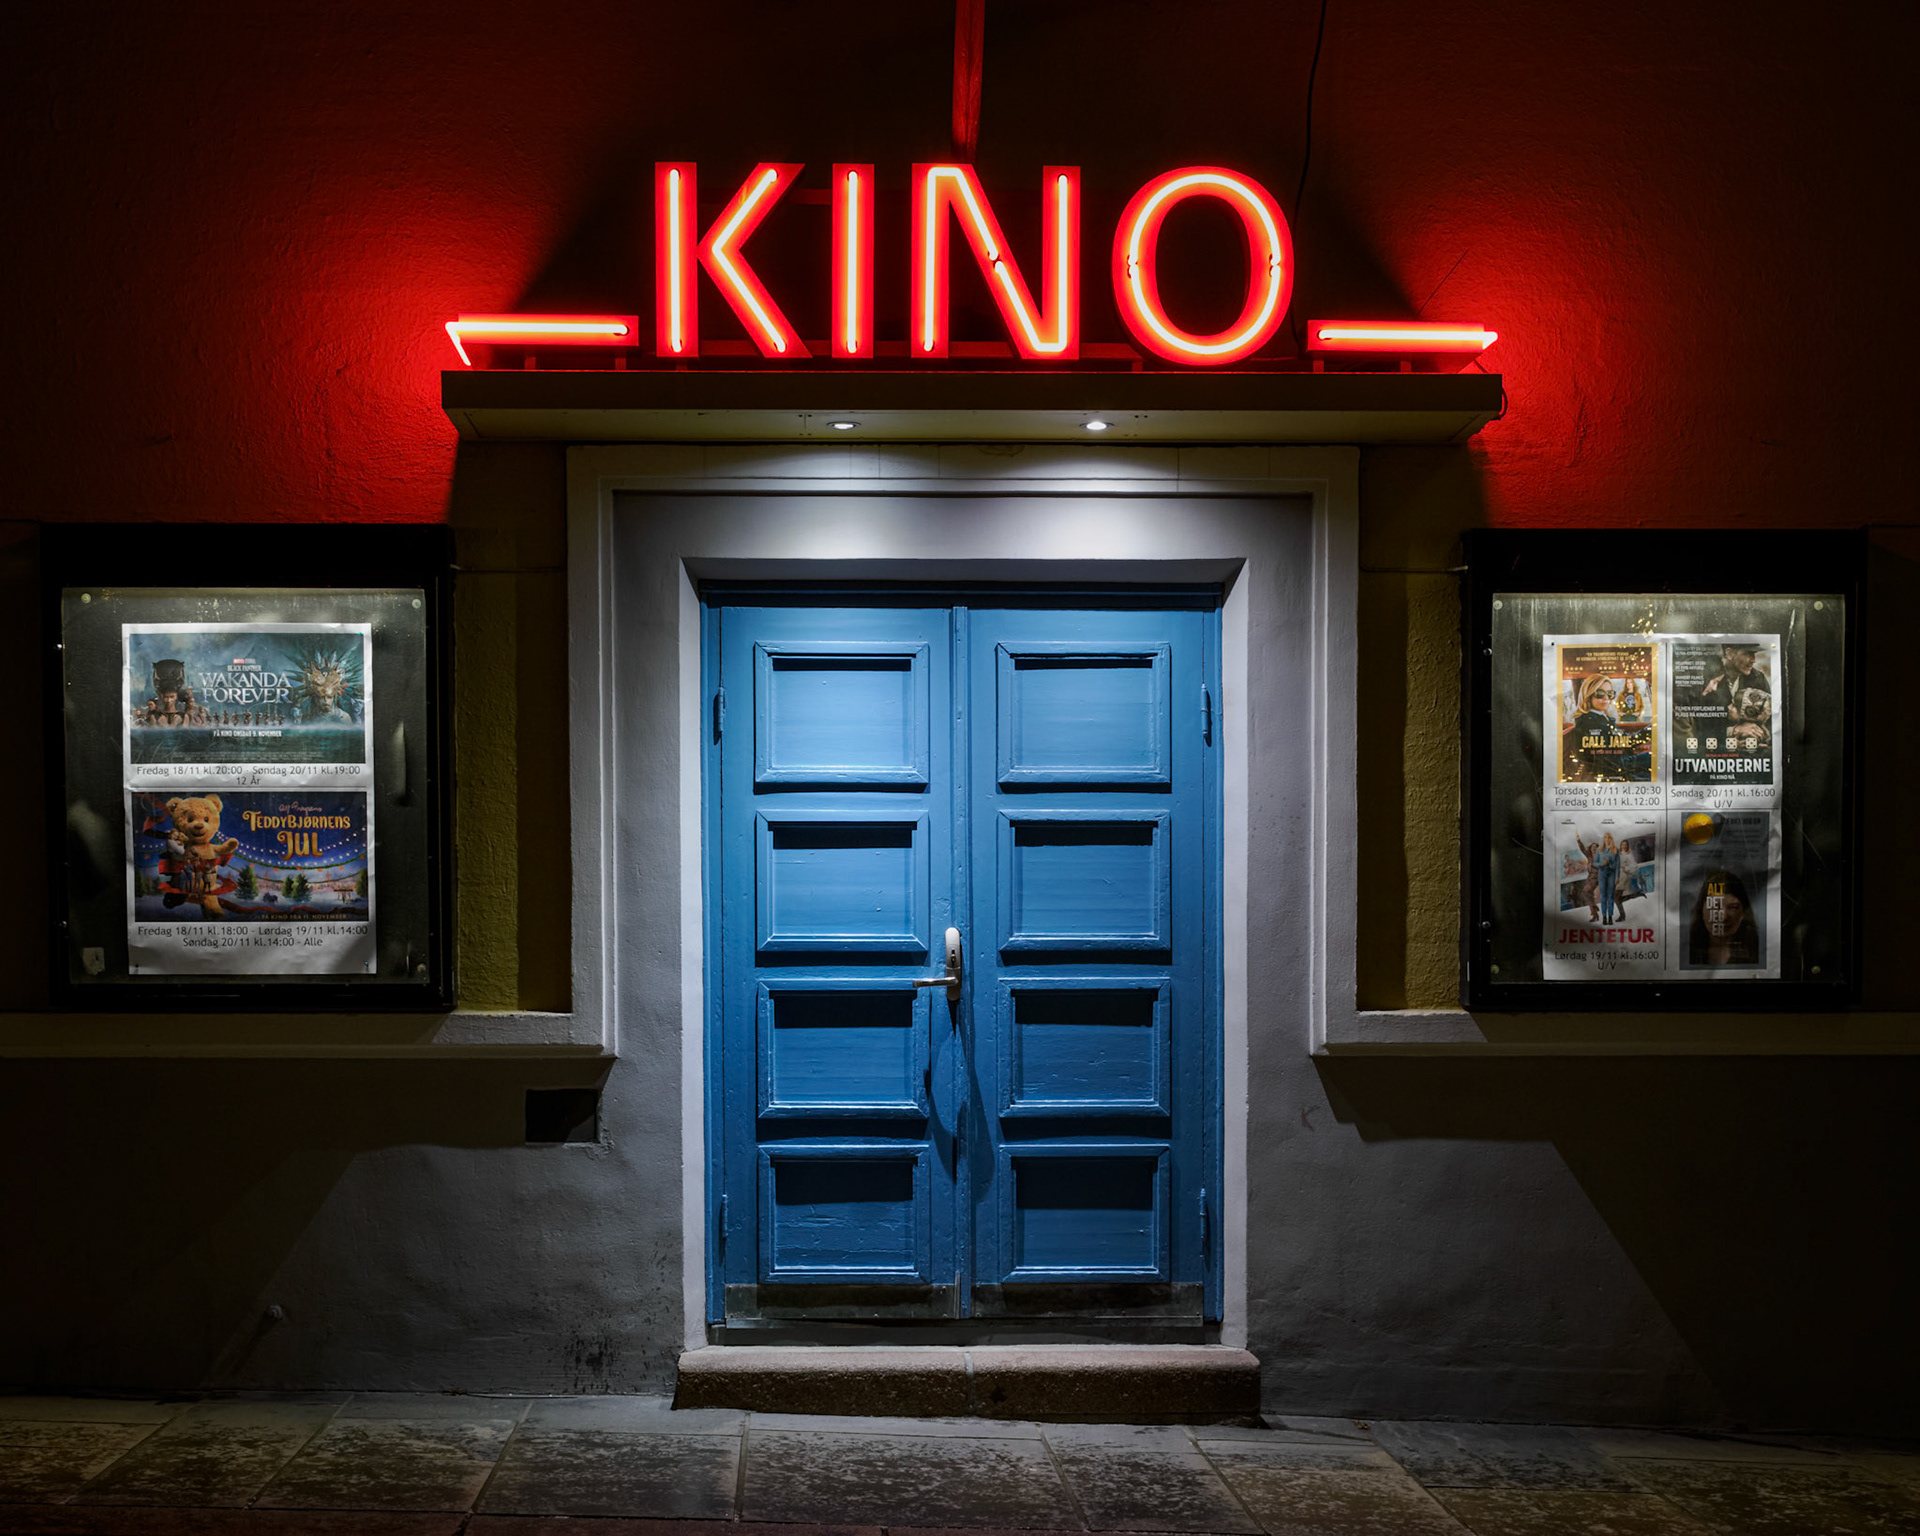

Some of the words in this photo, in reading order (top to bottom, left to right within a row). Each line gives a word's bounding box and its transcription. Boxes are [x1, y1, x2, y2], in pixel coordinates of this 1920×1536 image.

[655, 161, 1294, 365] KINO
[198, 672, 292, 688] WAKANDA
[201, 688, 293, 705] FOREVER
[1582, 736, 1606, 748] CALL
[136, 766, 170, 777] Fredag
[173, 766, 200, 775] 18/11
[203, 766, 243, 775] kl.20:00
[252, 766, 287, 777] Søndag
[290, 766, 318, 775] 20/11
[321, 766, 360, 775] kl.19:00
[1675, 758, 1770, 773] UTVANDRERNE
[236, 777, 246, 786] 12
[250, 775, 261, 786] År
[1554, 786, 1589, 797] Torsdag
[1622, 787, 1662, 795] kl.20:30
[1671, 788, 1704, 799] Søndag
[1706, 788, 1734, 797] 20/11
[1738, 788, 1776, 797] kl.16:00
[1555, 798, 1588, 808] Fredag
[1591, 798, 1617, 806] 18/11
[1620, 798, 1660, 806] kl.12:00
[1714, 800, 1732, 809] U/V
[276, 830, 324, 861] JUL
[1707, 882, 1724, 896] ALT
[1706, 896, 1725, 909] DET
[1708, 910, 1725, 922] JEG
[138, 926, 172, 937] Fredag
[175, 926, 204, 936] 18/11
[207, 926, 249, 936] kl.18:00
[258, 926, 293, 937] Lørdag
[296, 926, 324, 936] 19/11
[327, 926, 369, 936] kl.14:00
[1712, 923, 1724, 936] ER
[183, 937, 219, 948] Søndag
[222, 938, 250, 946] 20/11
[254, 938, 295, 946] kl.14:00
[304, 938, 323, 946] Alle
[1558, 929, 1655, 944] JENTETUR
[1554, 951, 1587, 962] Lørdag
[1590, 951, 1616, 960] 19/11
[1620, 951, 1660, 960] kl.16:00
[1598, 962, 1616, 971] U/V
